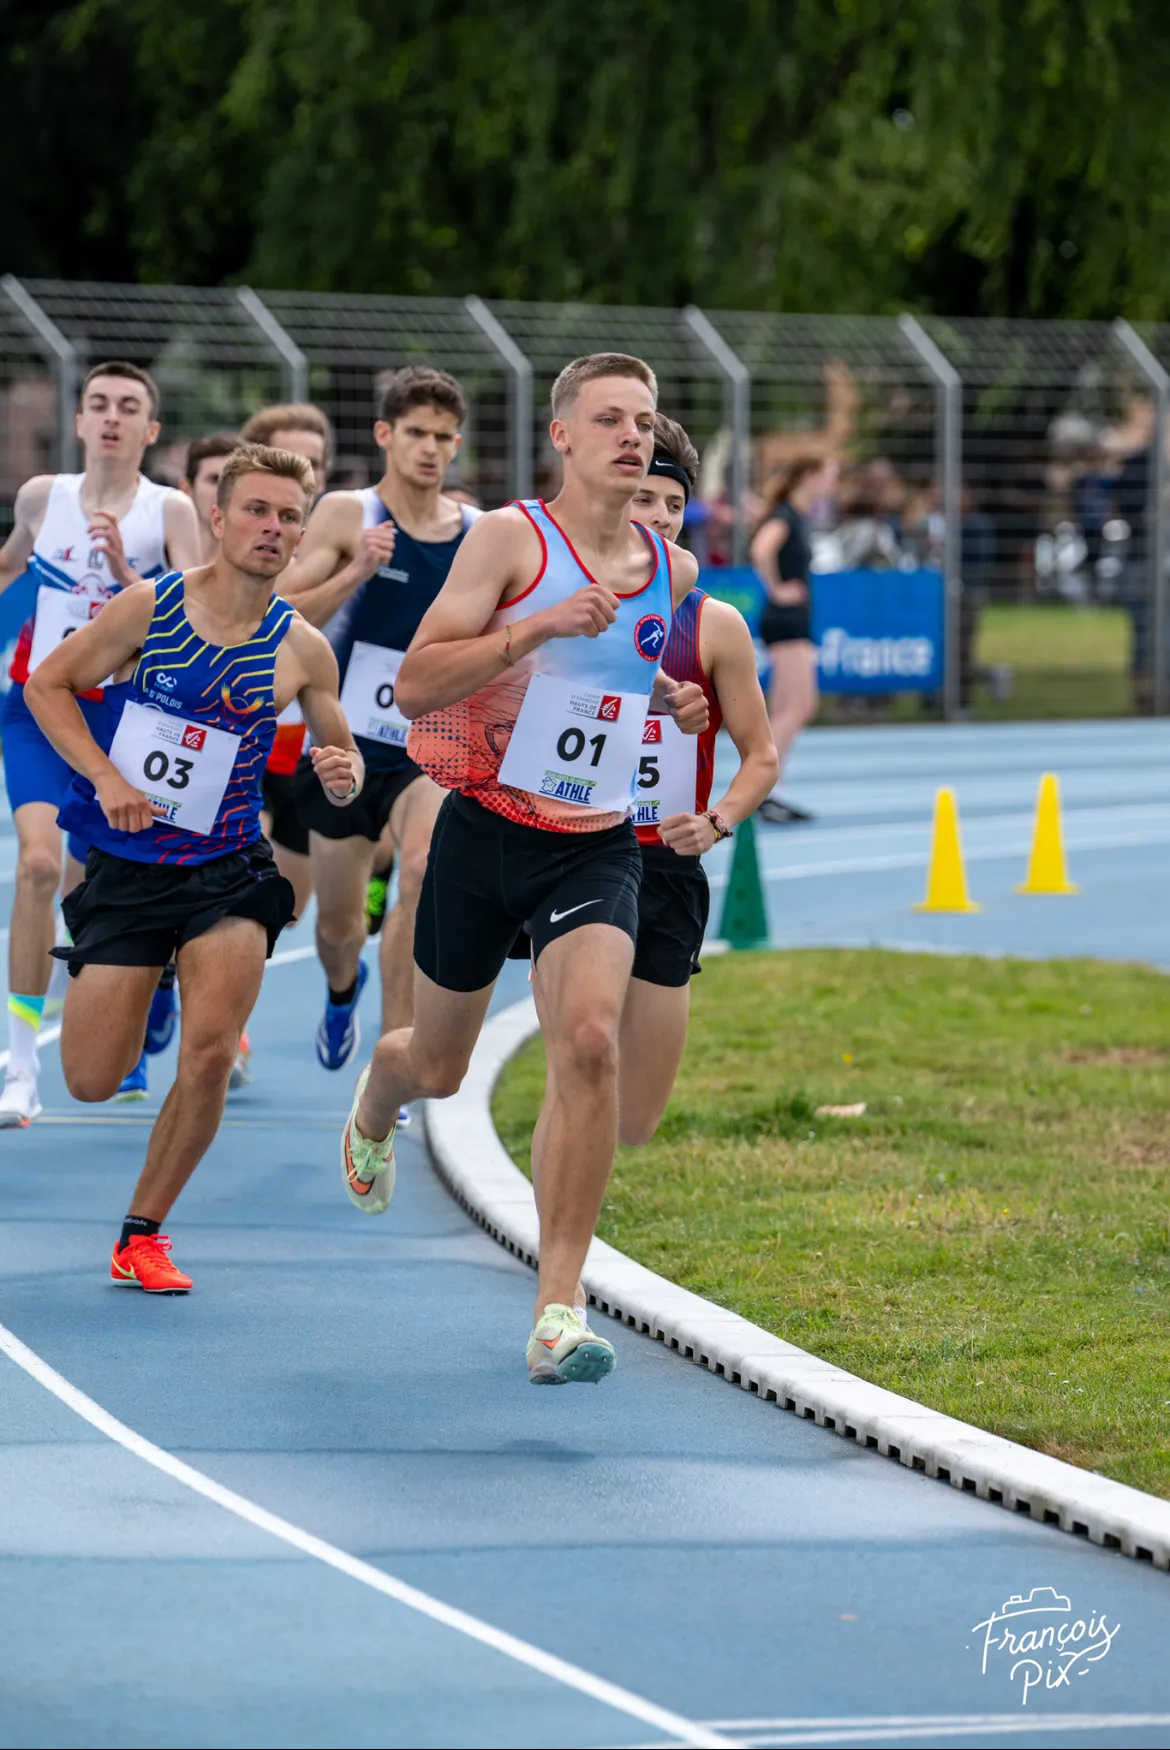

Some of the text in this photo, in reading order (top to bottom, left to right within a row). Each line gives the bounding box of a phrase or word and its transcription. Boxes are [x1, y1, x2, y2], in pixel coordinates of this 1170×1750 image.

[376, 683, 394, 708] 0
[573, 706, 596, 716] FRANCE
[556, 727, 607, 767] 01
[143, 750, 195, 789] 03
[637, 756, 660, 788] 5
[555, 780, 592, 801] ATHLE
